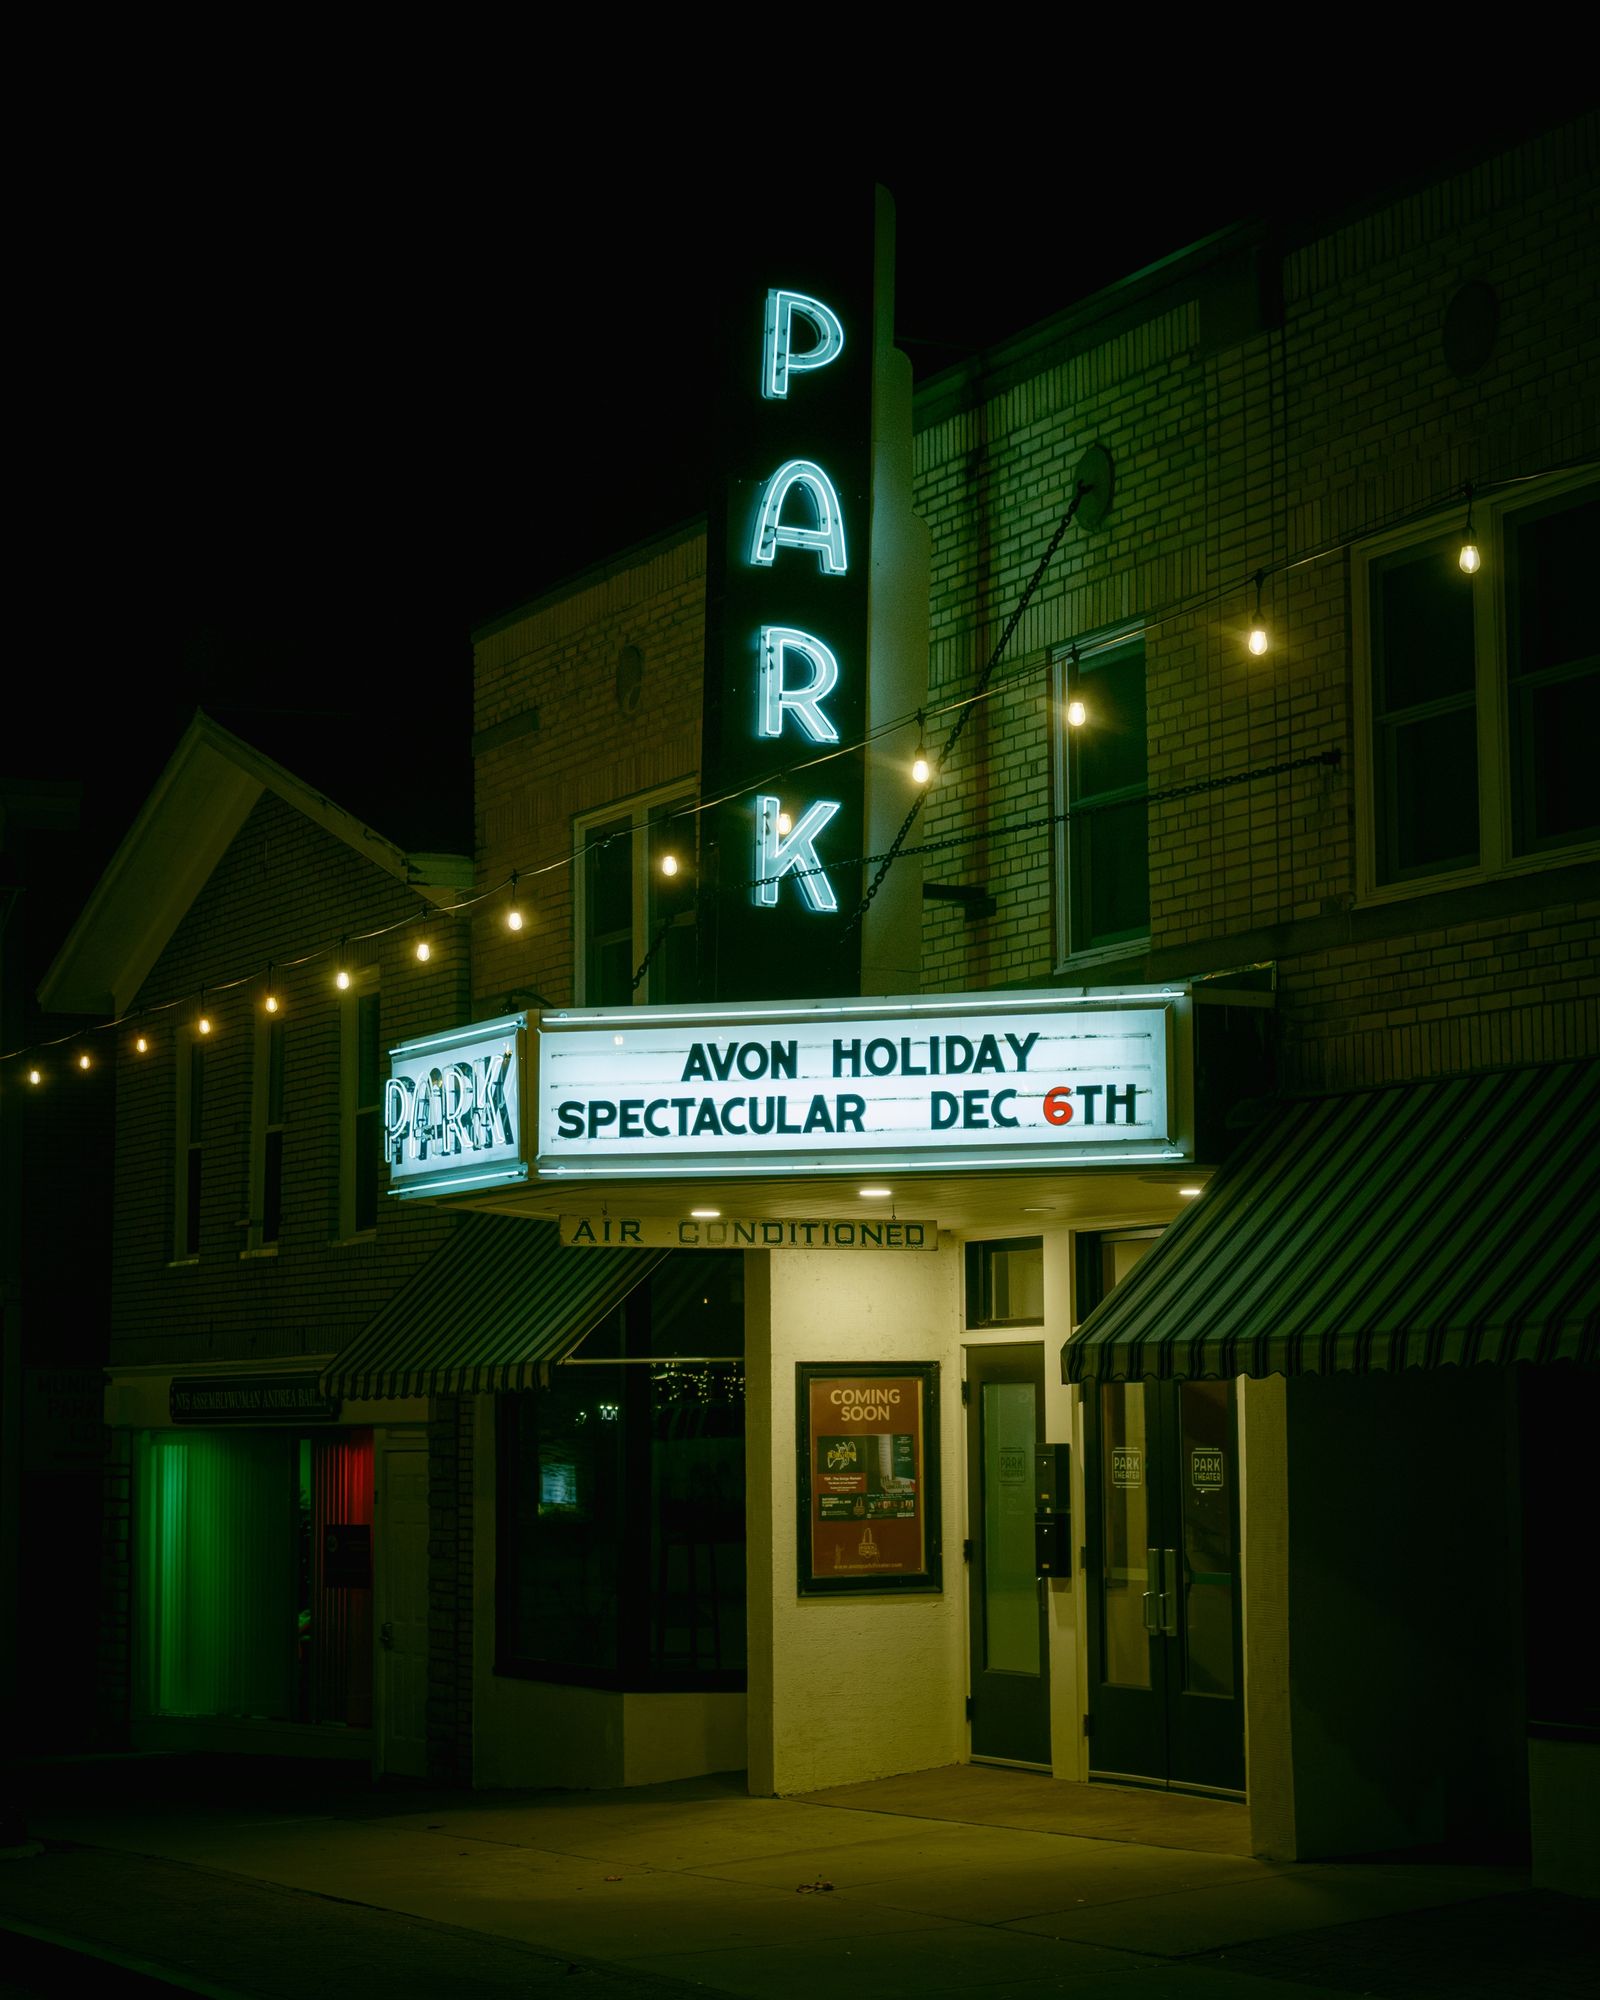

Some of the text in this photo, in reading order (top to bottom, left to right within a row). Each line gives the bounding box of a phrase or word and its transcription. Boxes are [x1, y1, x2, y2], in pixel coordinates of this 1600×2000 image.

[749, 287, 847, 914] PARK
[681, 1032, 1040, 1083] AVON HOLIDAY
[384, 1052, 515, 1165] PARK
[556, 1083, 1136, 1139] SPECTACULAR DEC 6TH
[572, 1220, 925, 1248] AIR CONDITIONED
[830, 1389, 901, 1404] COMING
[841, 1406, 890, 1421] SOON
[1113, 1456, 1141, 1470] PARK
[1193, 1457, 1221, 1472] PARK
[1113, 1471, 1141, 1480] THEATER
[1193, 1472, 1222, 1481] THEATER
